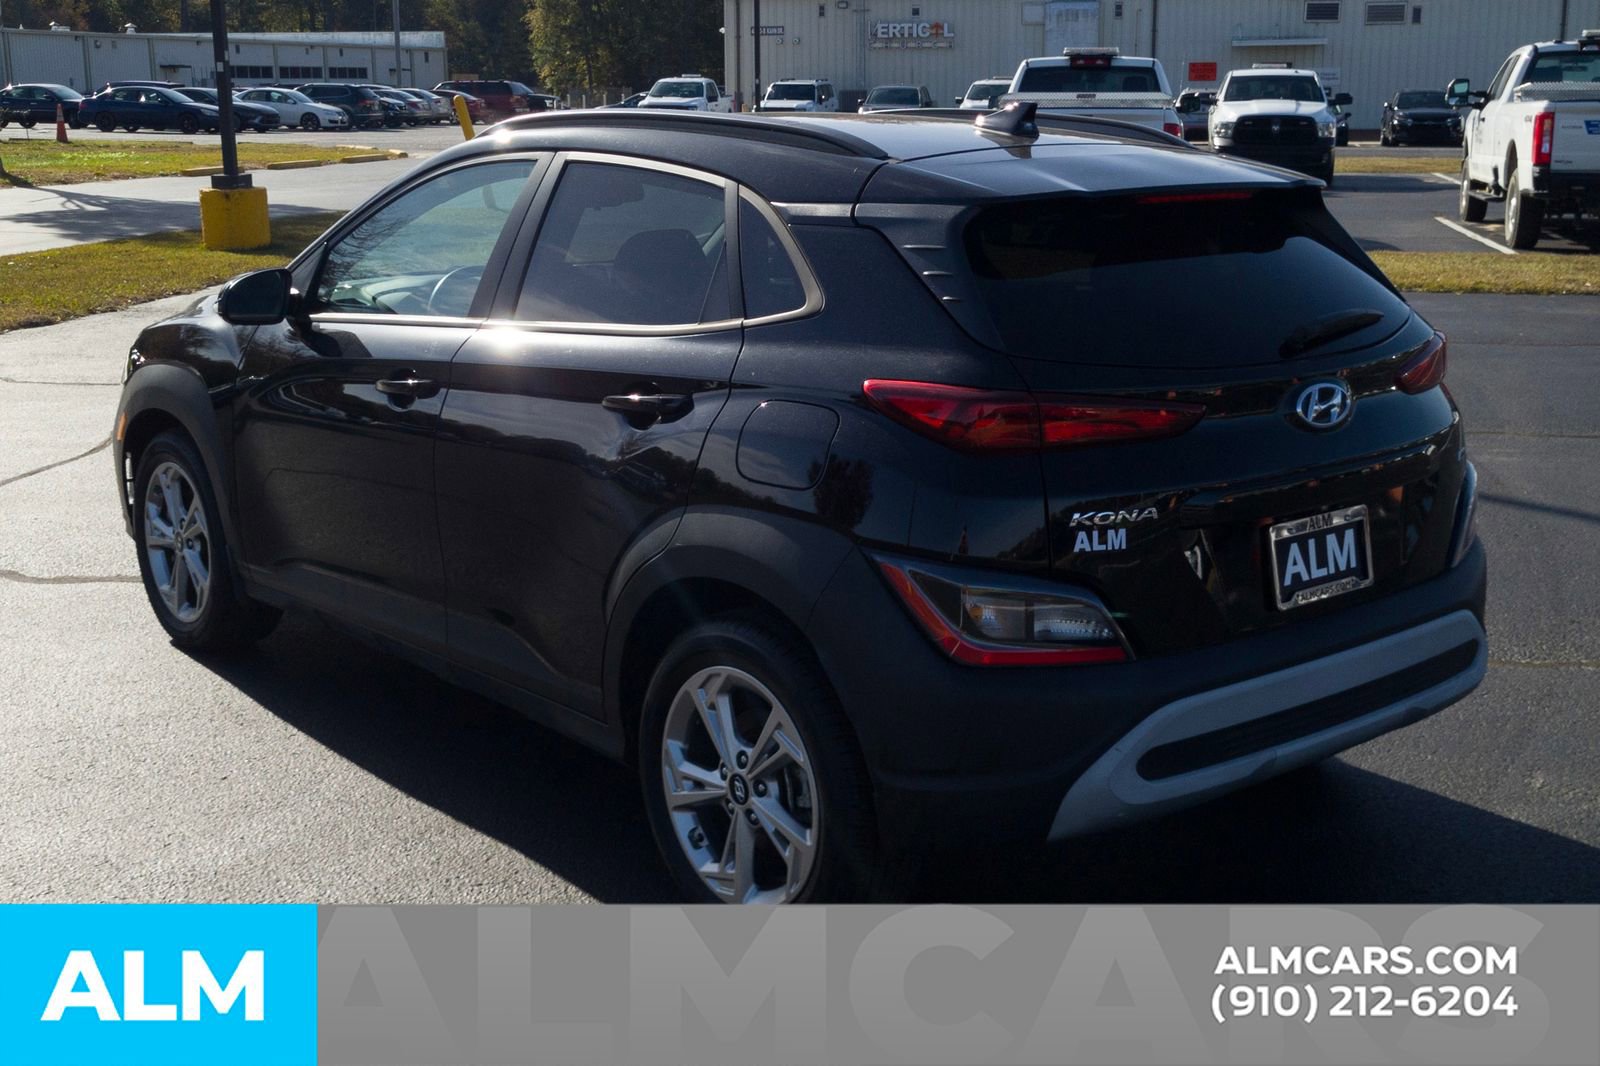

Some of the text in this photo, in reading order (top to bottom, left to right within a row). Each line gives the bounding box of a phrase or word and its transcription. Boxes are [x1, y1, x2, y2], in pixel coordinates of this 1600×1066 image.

[1069, 507, 1158, 527] KONA
[1307, 513, 1333, 532] ALM
[1073, 528, 1126, 552] ALM
[1283, 528, 1357, 587] ALM
